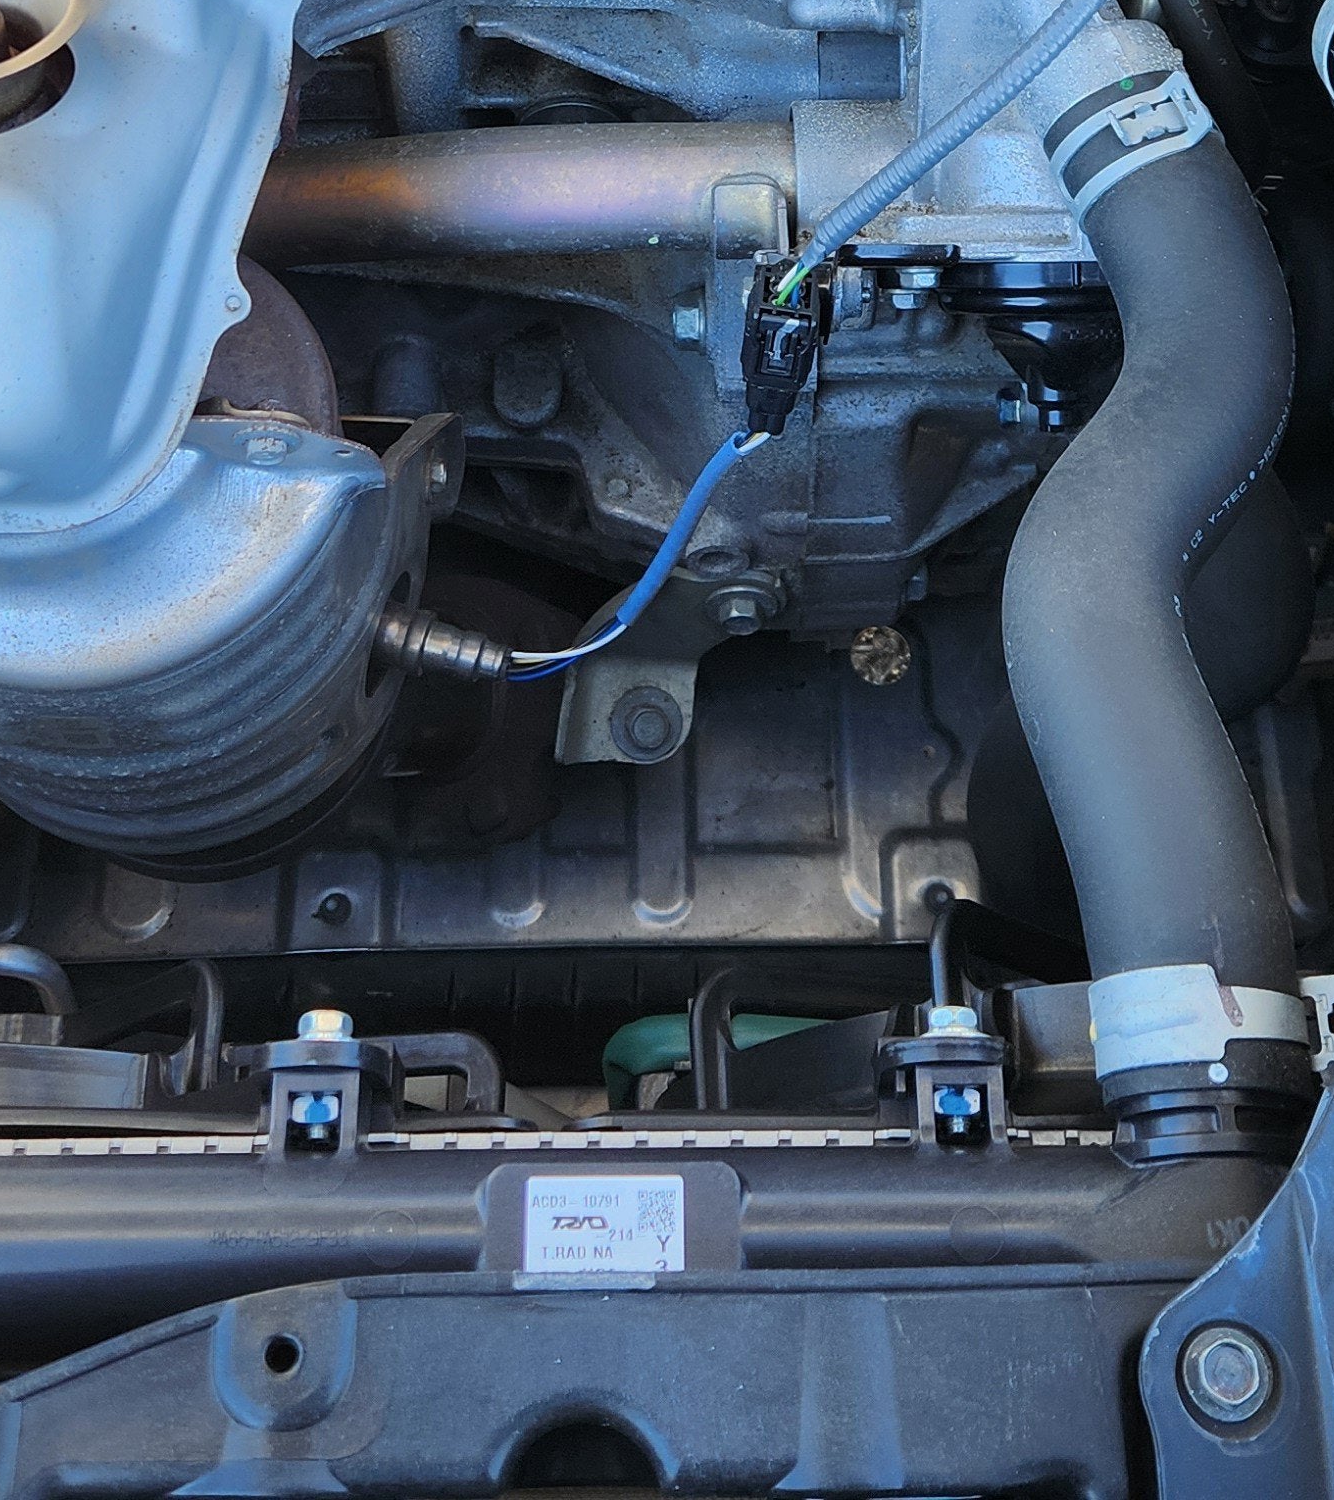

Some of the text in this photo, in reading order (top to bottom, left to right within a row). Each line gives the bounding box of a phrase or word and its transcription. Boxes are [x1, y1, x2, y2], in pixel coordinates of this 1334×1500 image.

[1208, 481, 1248, 524] Y-TEC
[542, 1246, 613, 1260] T.RAD NA
[657, 1235, 670, 1253] Y
